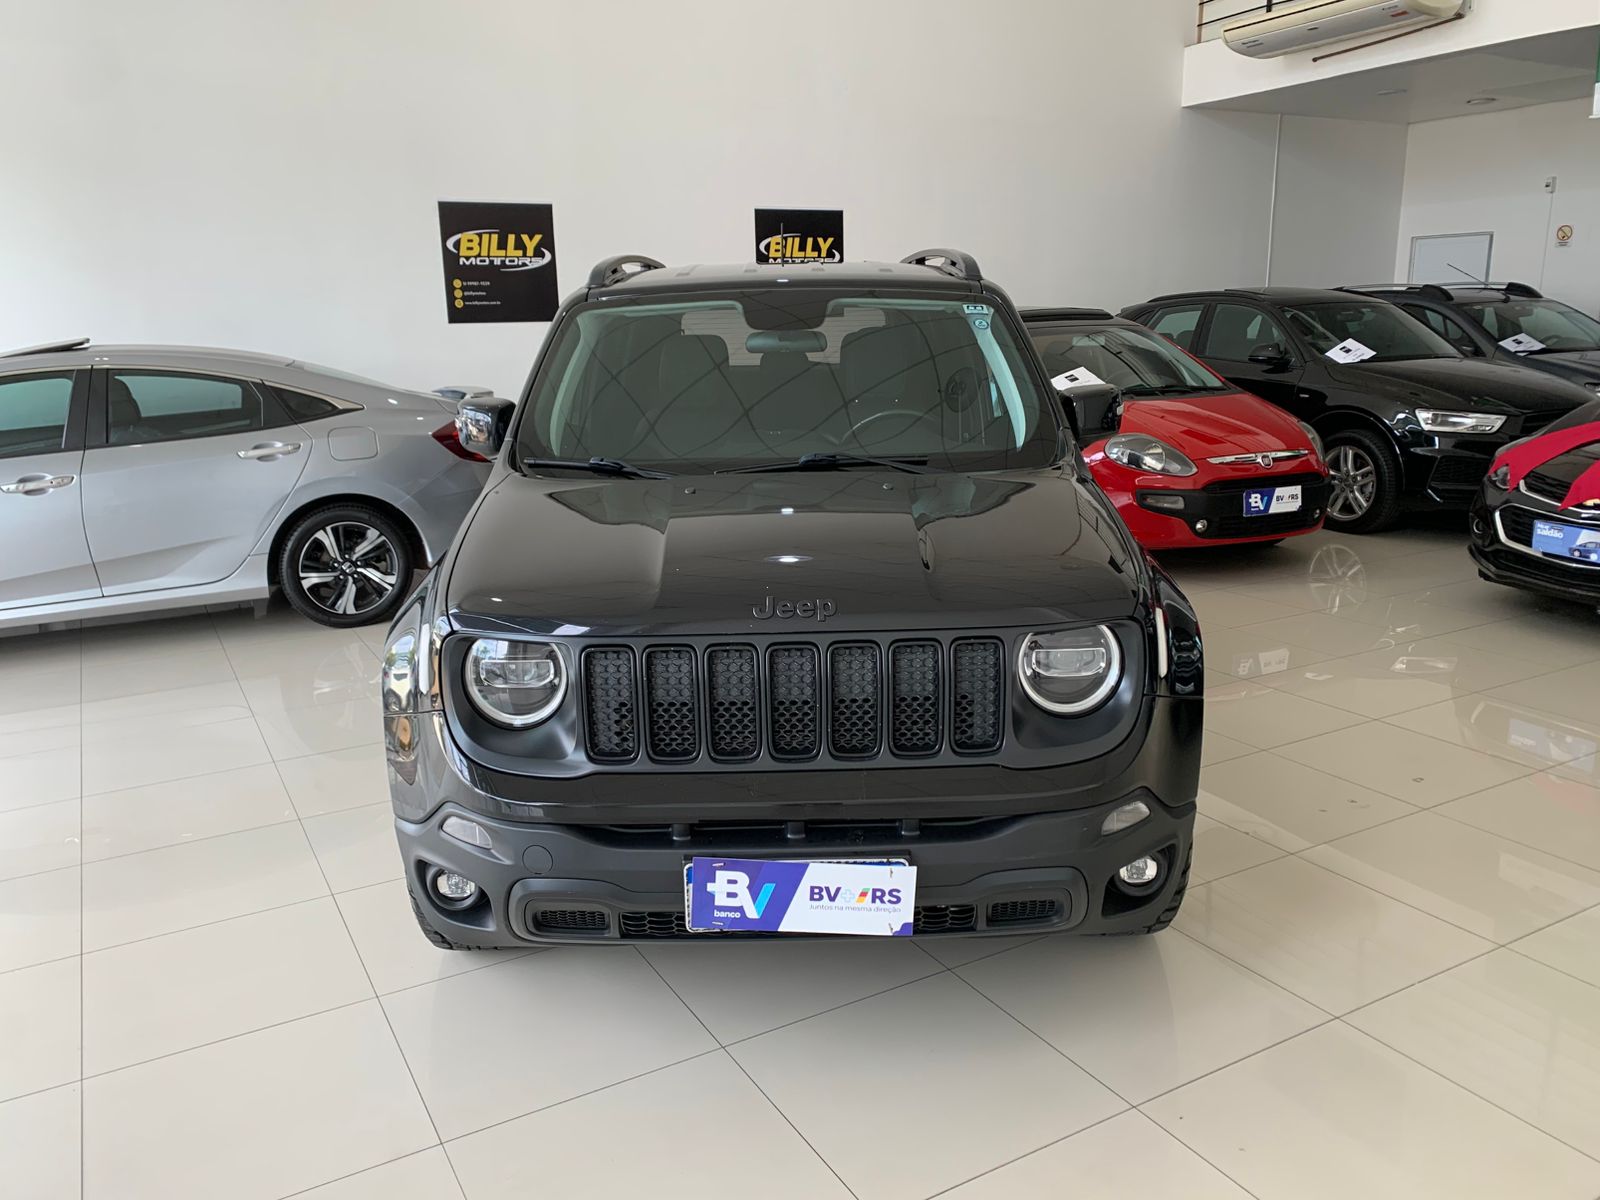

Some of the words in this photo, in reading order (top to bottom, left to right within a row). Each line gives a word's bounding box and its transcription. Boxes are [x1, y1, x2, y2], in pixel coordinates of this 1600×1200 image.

[459, 233, 543, 256] BILLY
[769, 237, 834, 257] BILLY
[460, 257, 543, 265] MOTORS
[752, 595, 838, 622] Jeep
[809, 885, 842, 902] BV
[871, 888, 902, 905] RS
[713, 909, 741, 918] banco
[845, 905, 872, 913] mesma
[873, 906, 902, 914] direção
